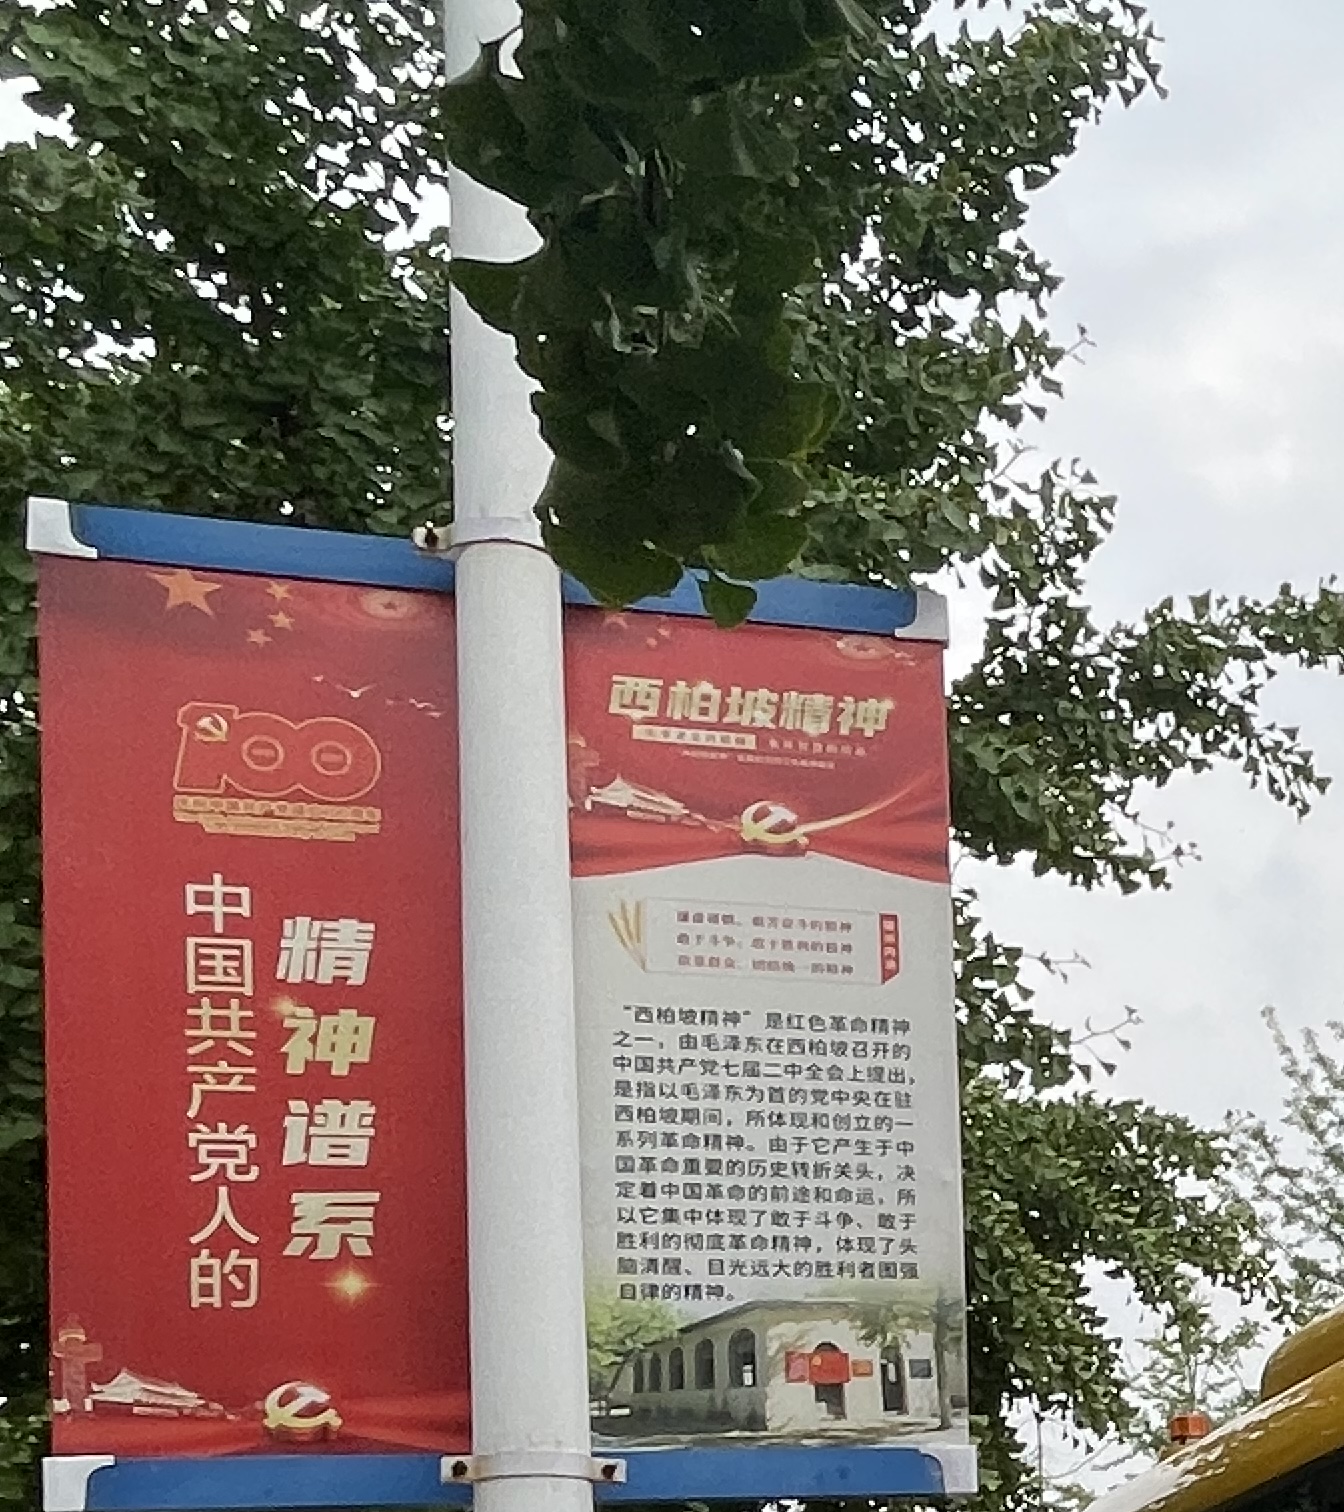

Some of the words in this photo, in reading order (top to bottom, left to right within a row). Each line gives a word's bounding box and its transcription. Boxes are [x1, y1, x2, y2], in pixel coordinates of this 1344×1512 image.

[608, 674, 896, 738] 西柏坡精神
[184, 872, 260, 1308] 中国共产党人的
[275, 917, 380, 1260] 精神谱系
